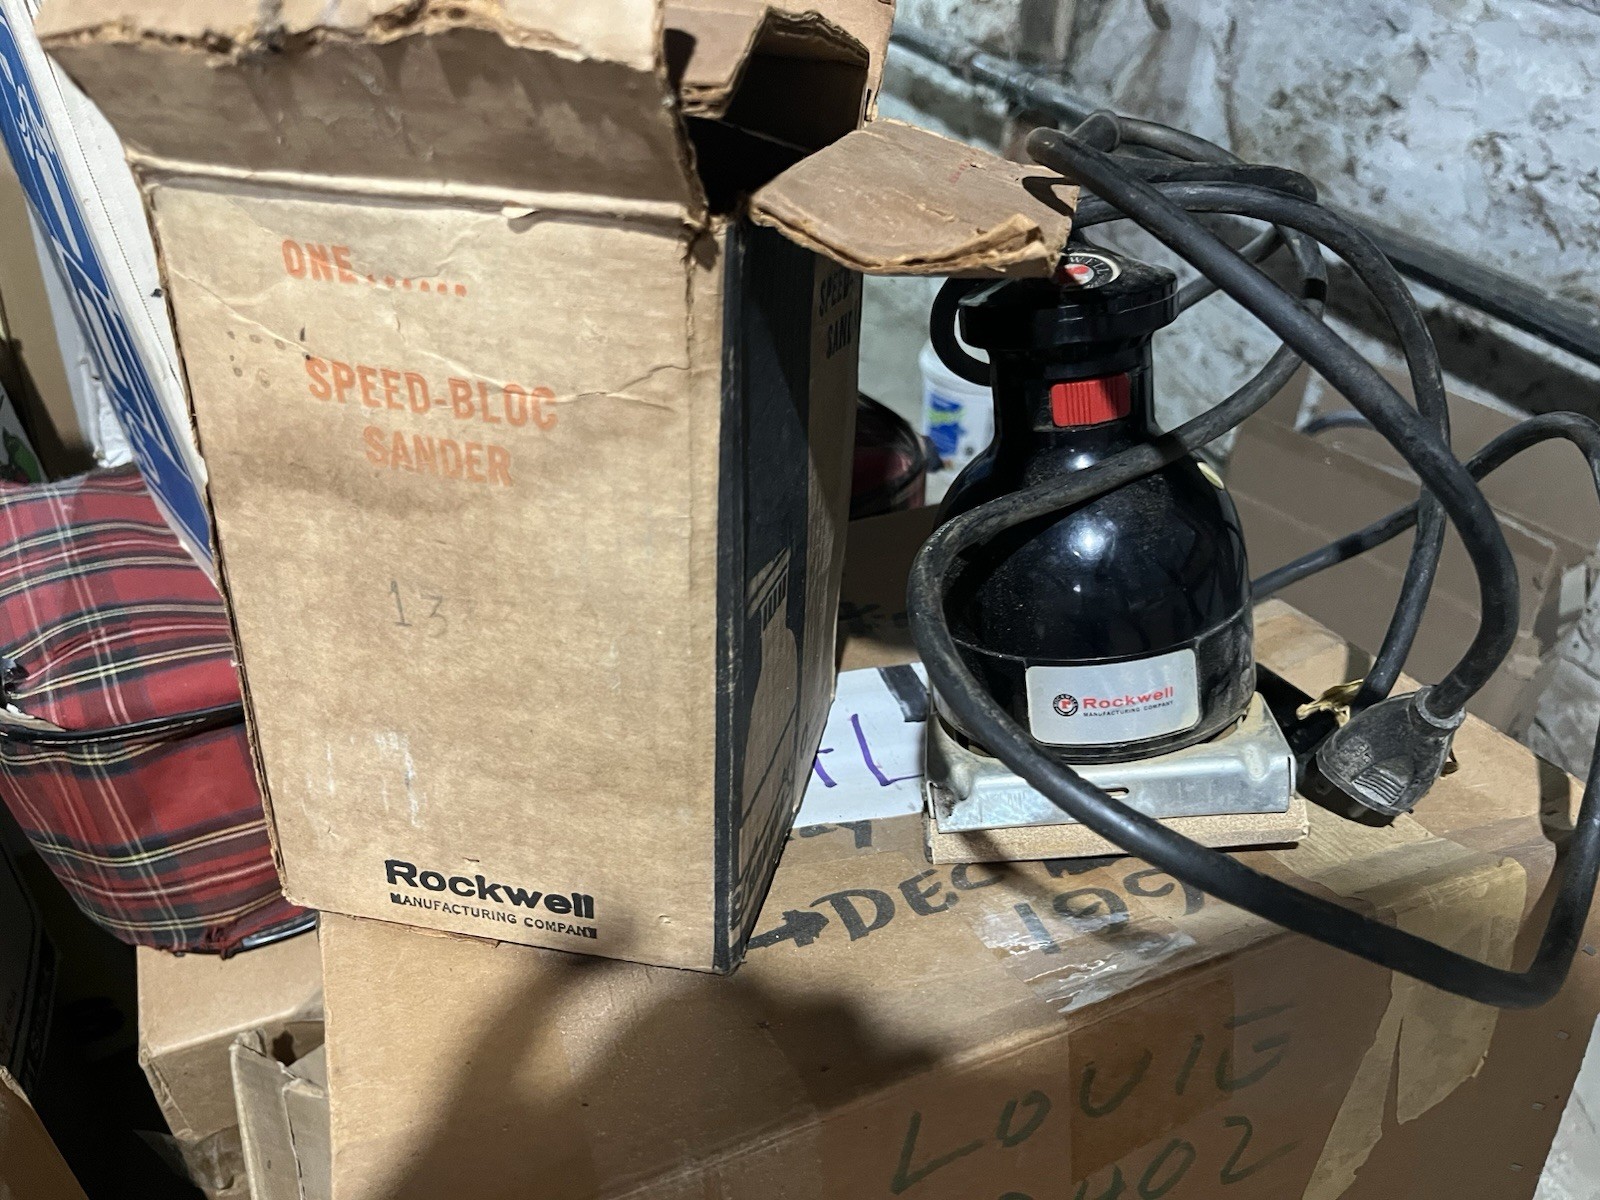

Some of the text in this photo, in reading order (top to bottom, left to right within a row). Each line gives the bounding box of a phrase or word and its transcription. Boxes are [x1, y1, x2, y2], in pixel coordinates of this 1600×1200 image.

[305, 357, 557, 430] SPEED-BLOC
[363, 425, 513, 487] SANDER
[1083, 686, 1174, 710] Rockwell
[1083, 700, 1175, 718] MANUFACTURING COMPANY
[385, 859, 595, 919] Rockwell
[390, 892, 598, 939] MANUFACTURING COMPANY
